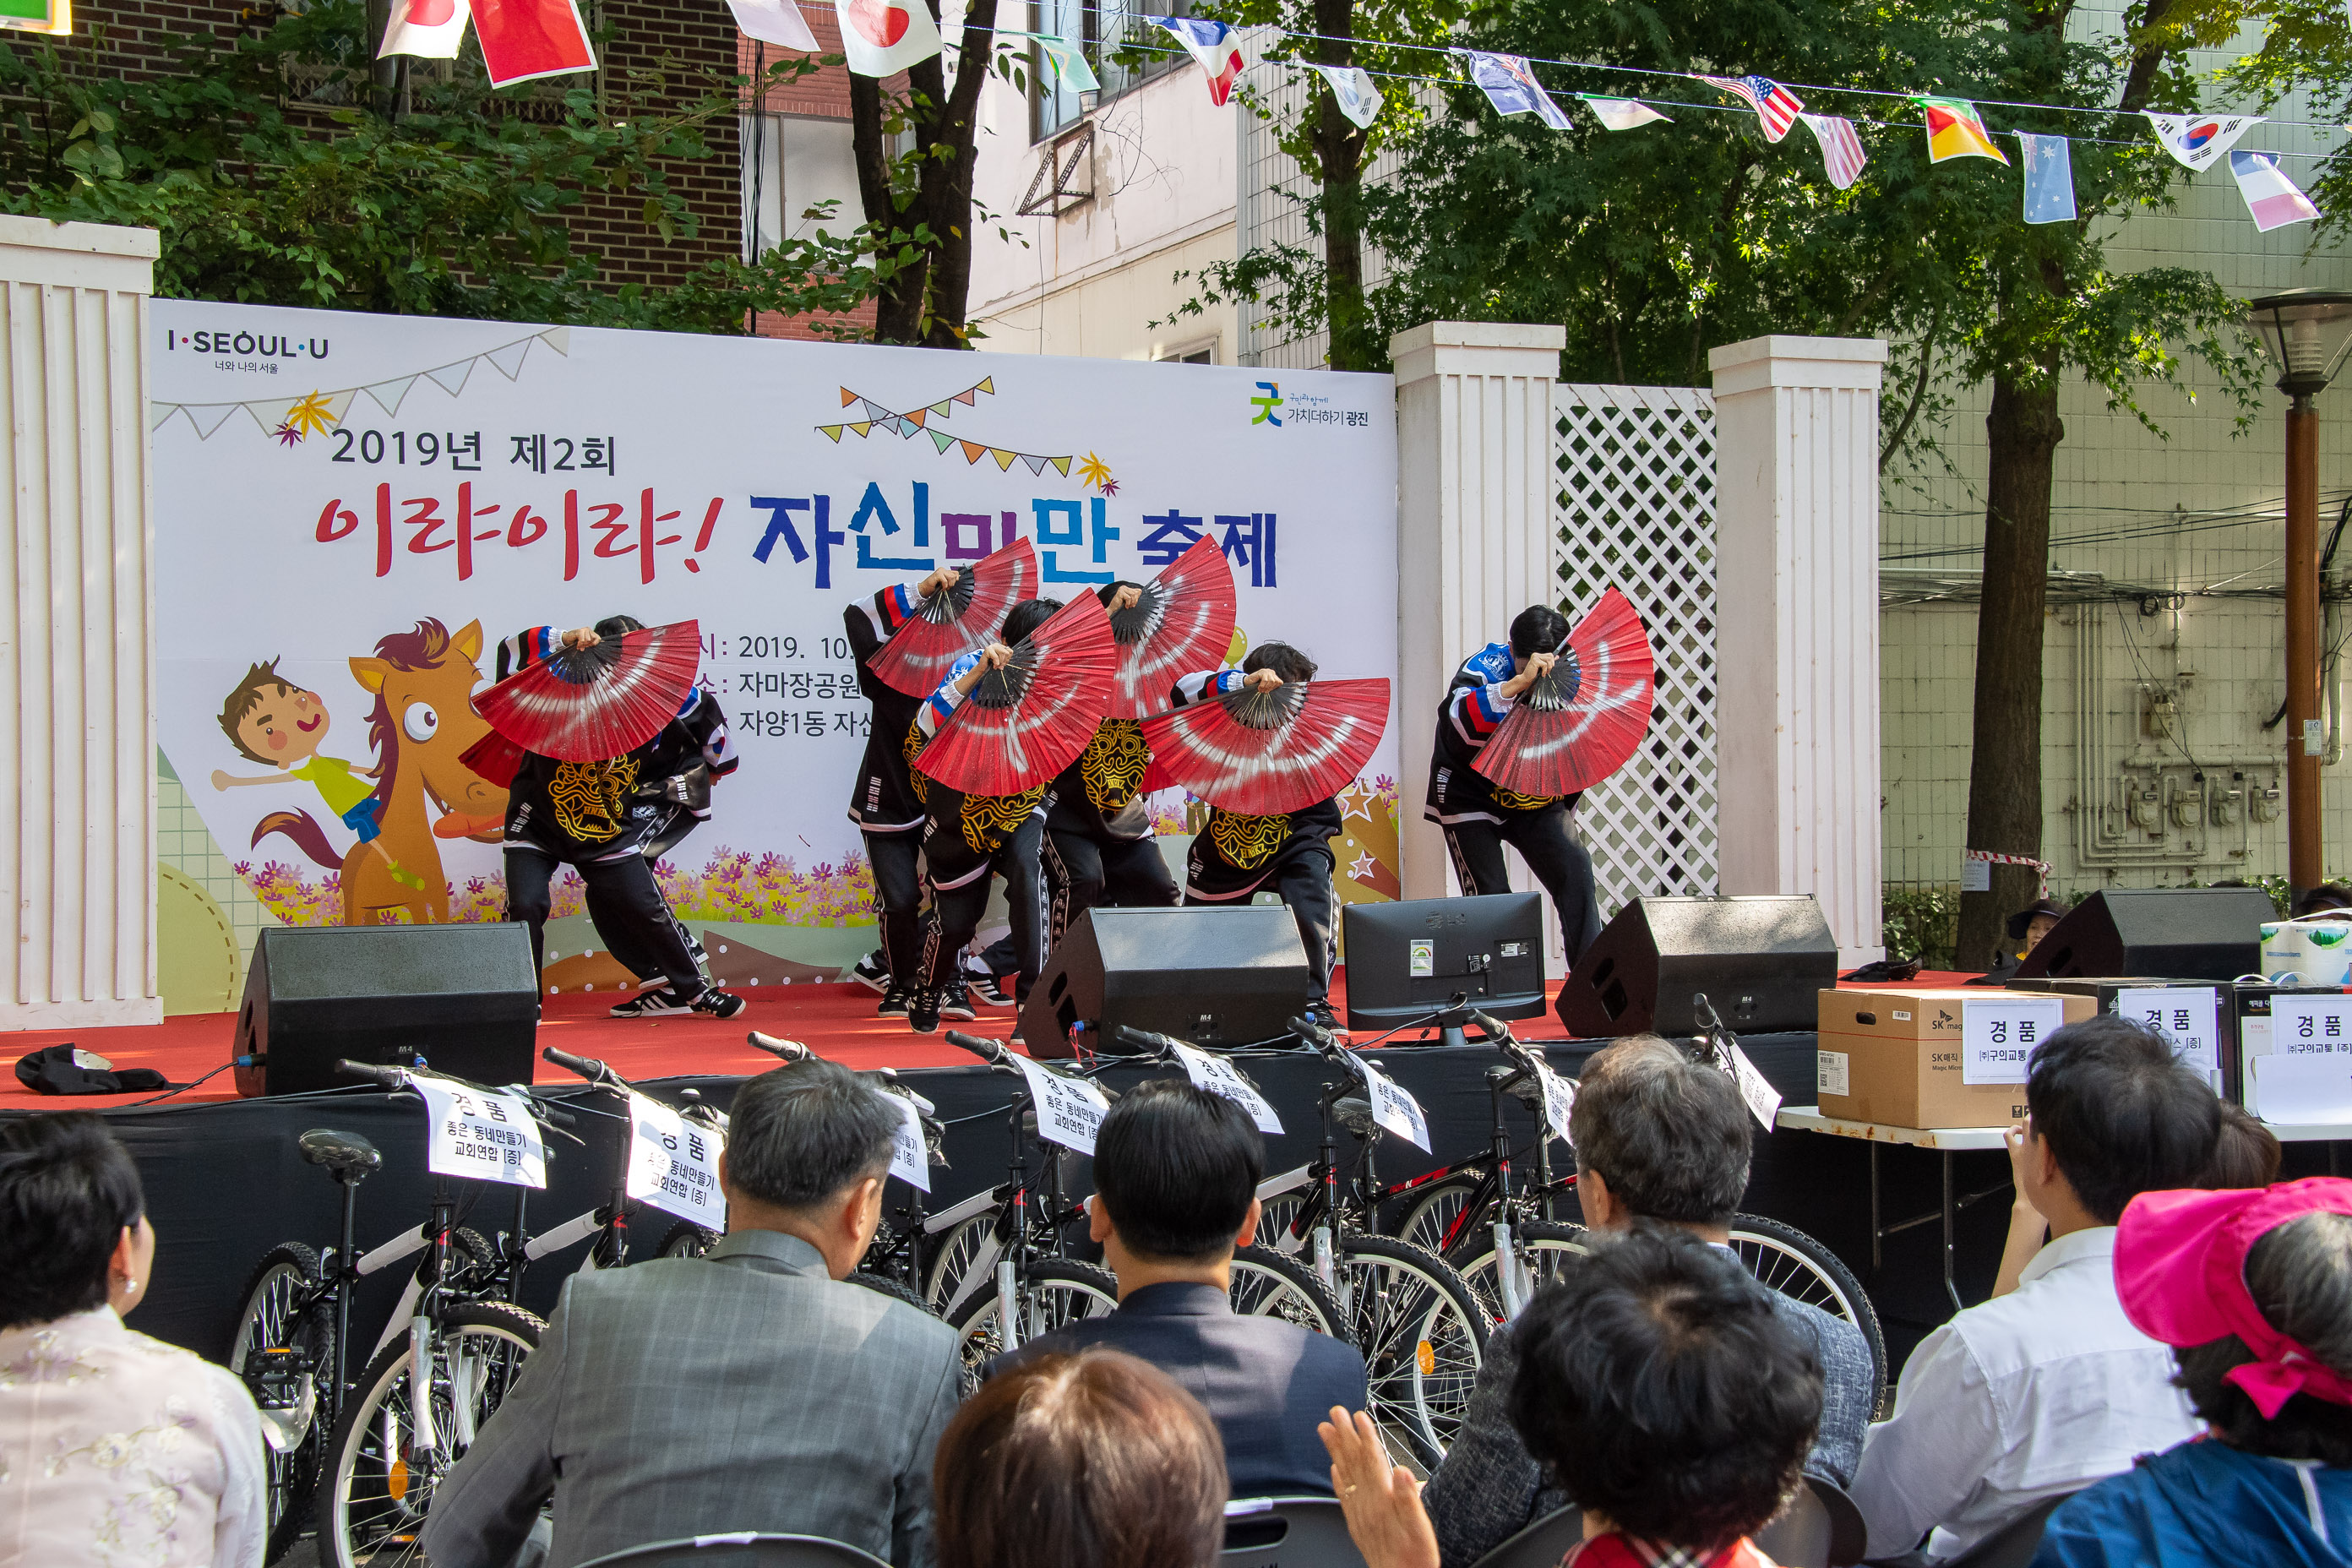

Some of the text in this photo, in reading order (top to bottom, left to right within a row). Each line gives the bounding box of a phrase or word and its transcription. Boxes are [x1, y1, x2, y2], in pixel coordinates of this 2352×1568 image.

[215, 361, 279, 374] 너와 나의 서울
[1289, 393, 1329, 406] 구민과 함께
[1288, 408, 1369, 427] 가치더하기 광진
[331, 428, 615, 476] 2019년 제2회
[1137, 509, 1277, 588] 축제
[738, 636, 805, 659] 2019.
[738, 672, 861, 699] 자마장공원
[738, 710, 827, 737] 자양1동
[1932, 1020, 1944, 1030] SK
[1931, 1053, 1958, 1063] SK매직
[1045, 1094, 1103, 1125] 좋은 동네만들기
[447, 1120, 527, 1148] 좋은 동네만들기
[1054, 1113, 1086, 1136] 교회연합
[455, 1141, 498, 1162] 교회연합
[651, 1172, 688, 1199] 교회연합
[670, 1159, 715, 1191] 동네만들기
